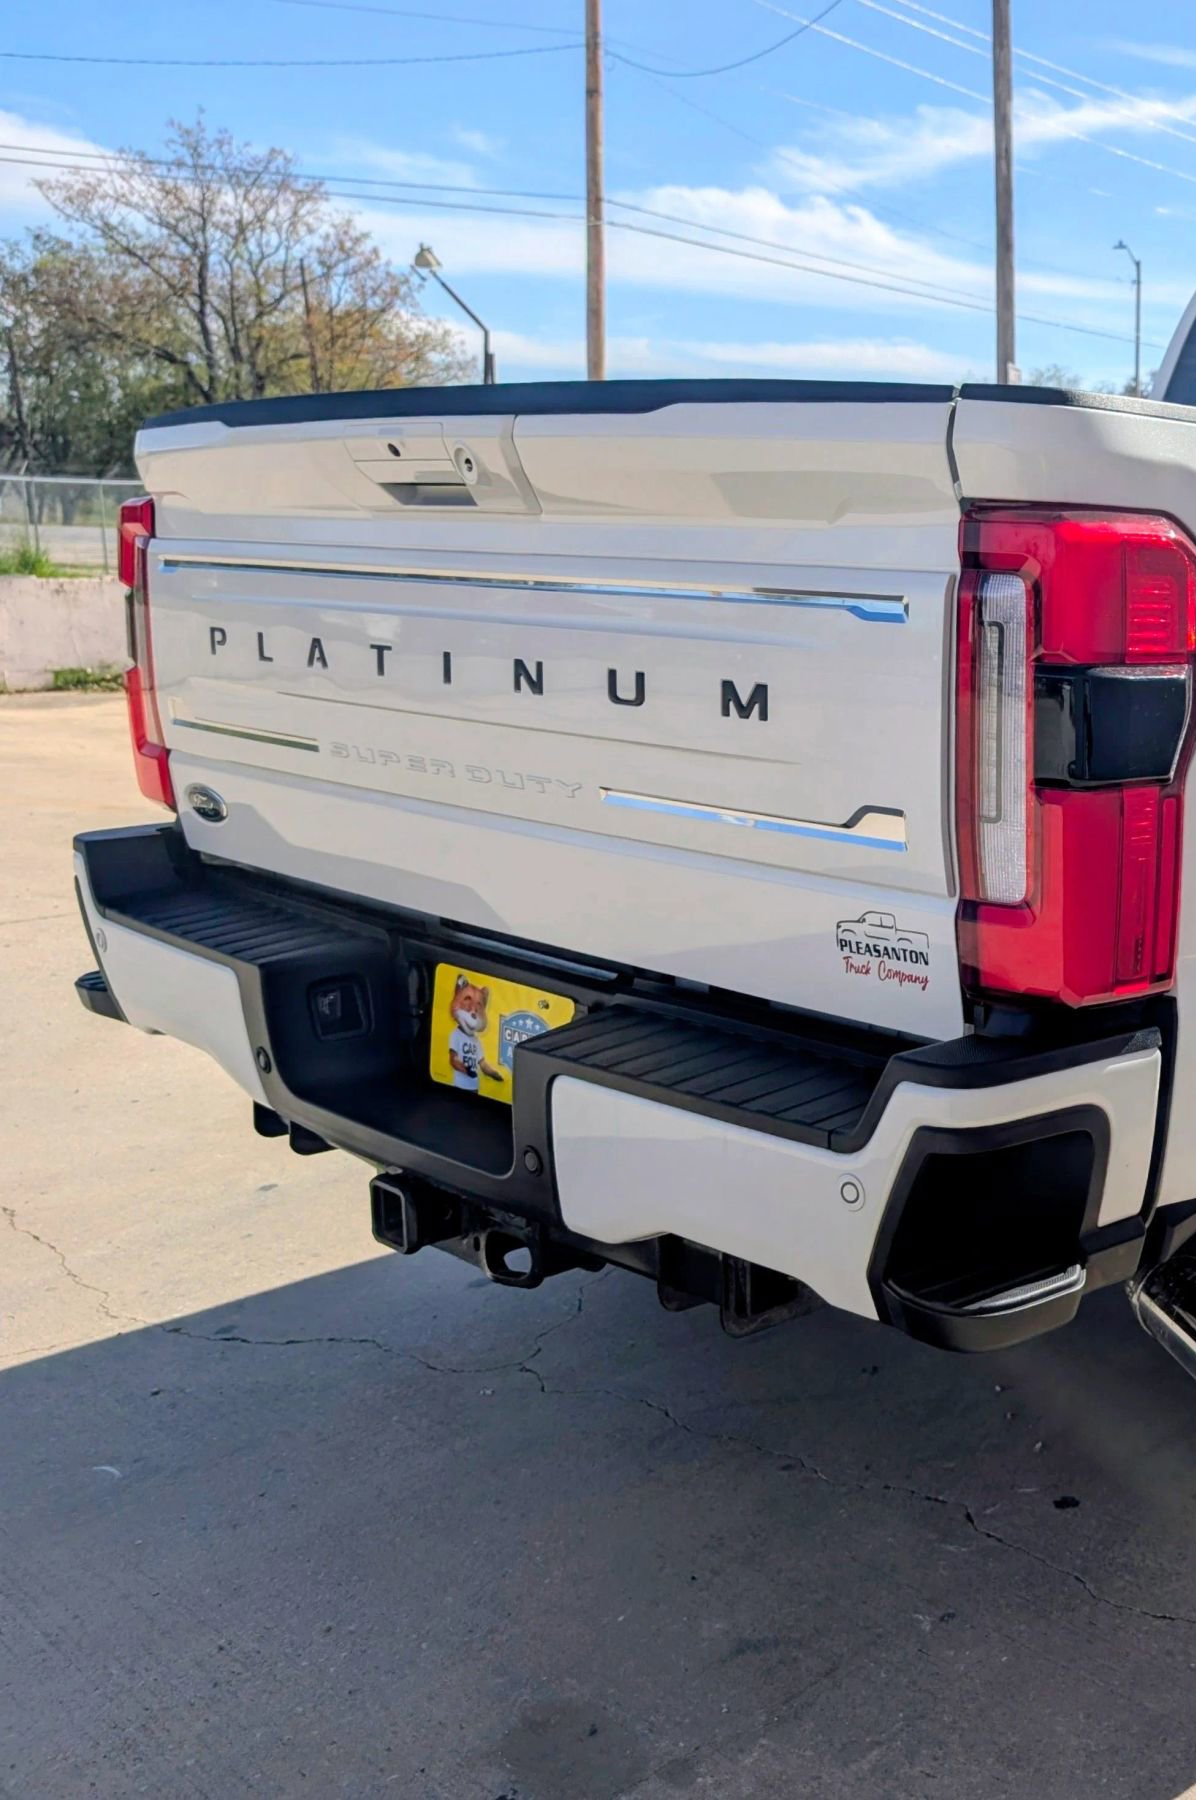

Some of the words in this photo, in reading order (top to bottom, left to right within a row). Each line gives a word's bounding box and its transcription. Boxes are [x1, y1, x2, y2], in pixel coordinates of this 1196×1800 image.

[209, 626, 768, 722] PLATINUM
[329, 741, 456, 778] SUPER
[464, 764, 582, 799] DUTY
[839, 938, 929, 966] PLEASANTON
[842, 955, 872, 976] Truck
[877, 960, 930, 991] Company
